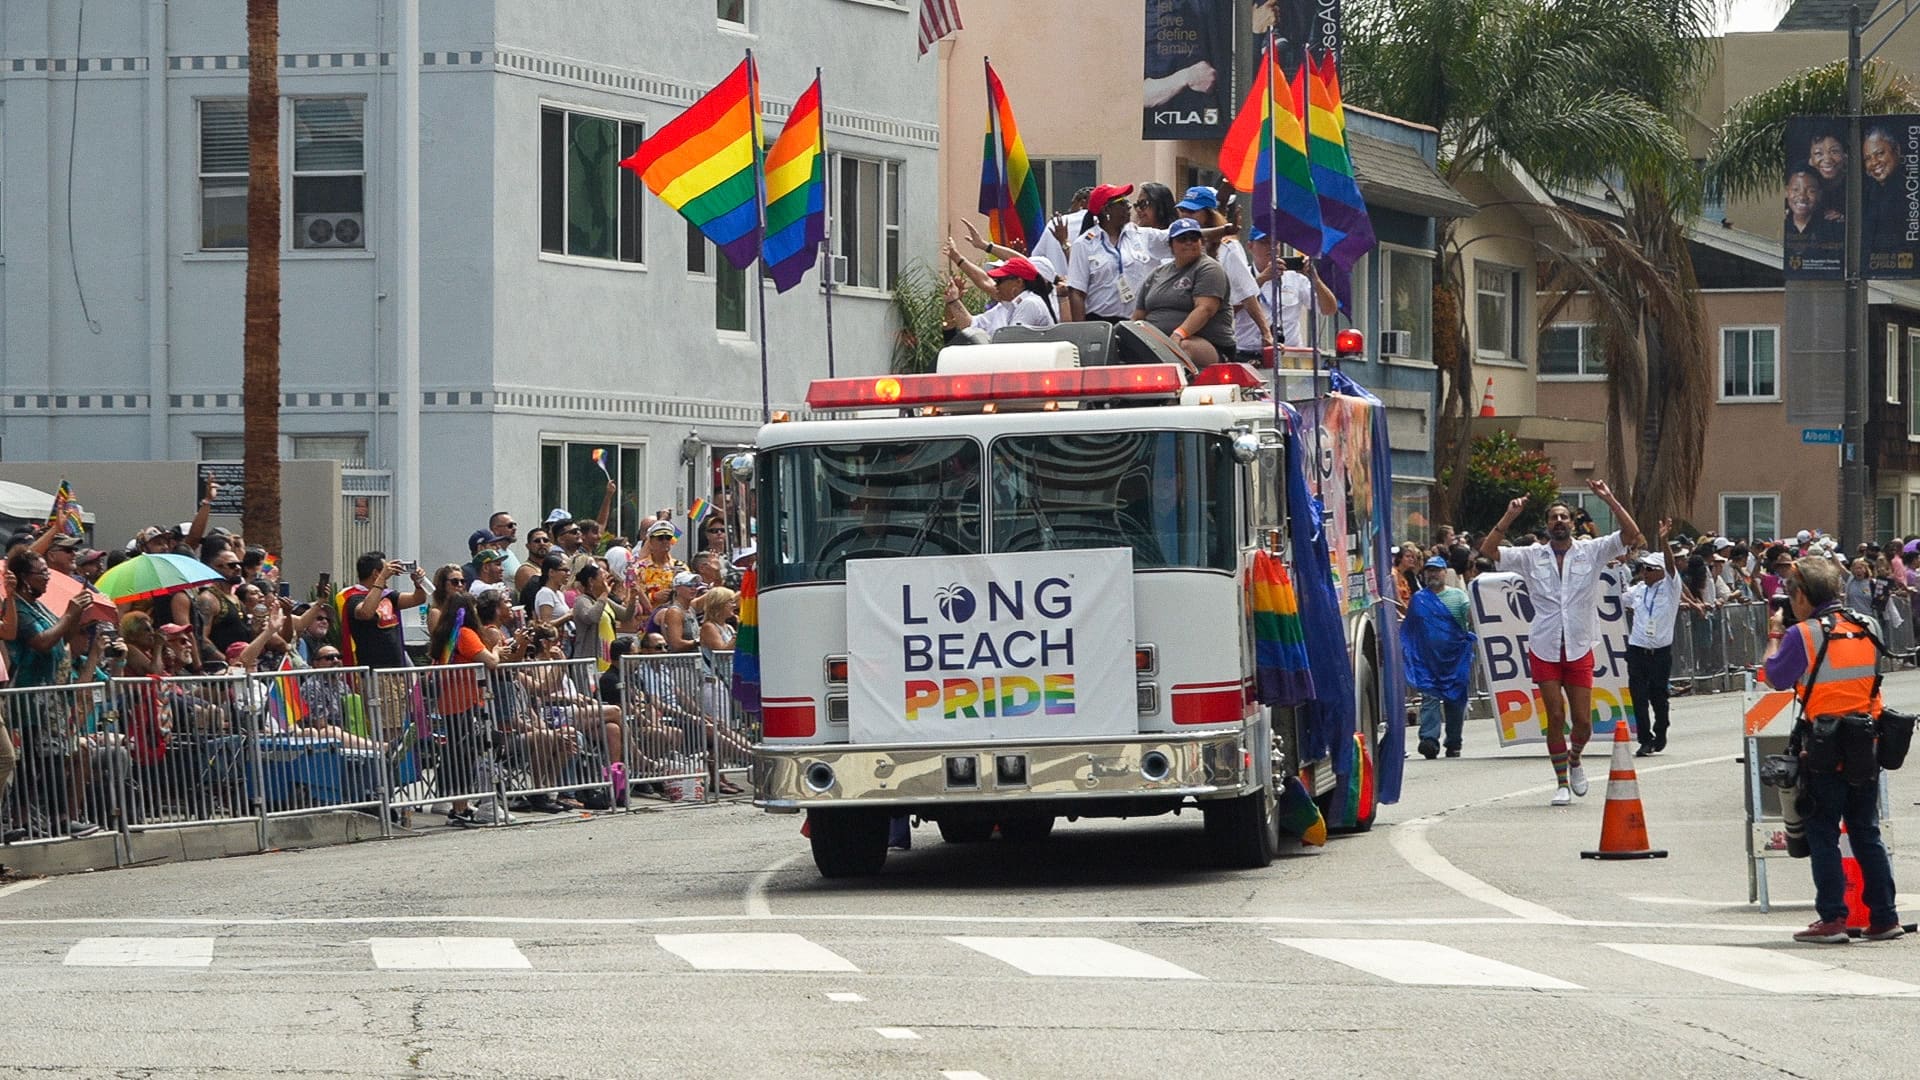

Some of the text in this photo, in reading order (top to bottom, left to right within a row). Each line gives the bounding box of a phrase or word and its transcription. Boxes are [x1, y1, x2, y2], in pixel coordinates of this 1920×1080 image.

[1156, 28, 1198, 41] define
[1157, 15, 1185, 28] love
[1156, 41, 1195, 57] family
[1154, 108, 1218, 125] KTLA 5
[1906, 125, 1920, 241] RaiseAChild.org
[902, 577, 1073, 625] LONG
[903, 627, 1075, 673] BEACH
[904, 673, 1077, 721] PRIDE
